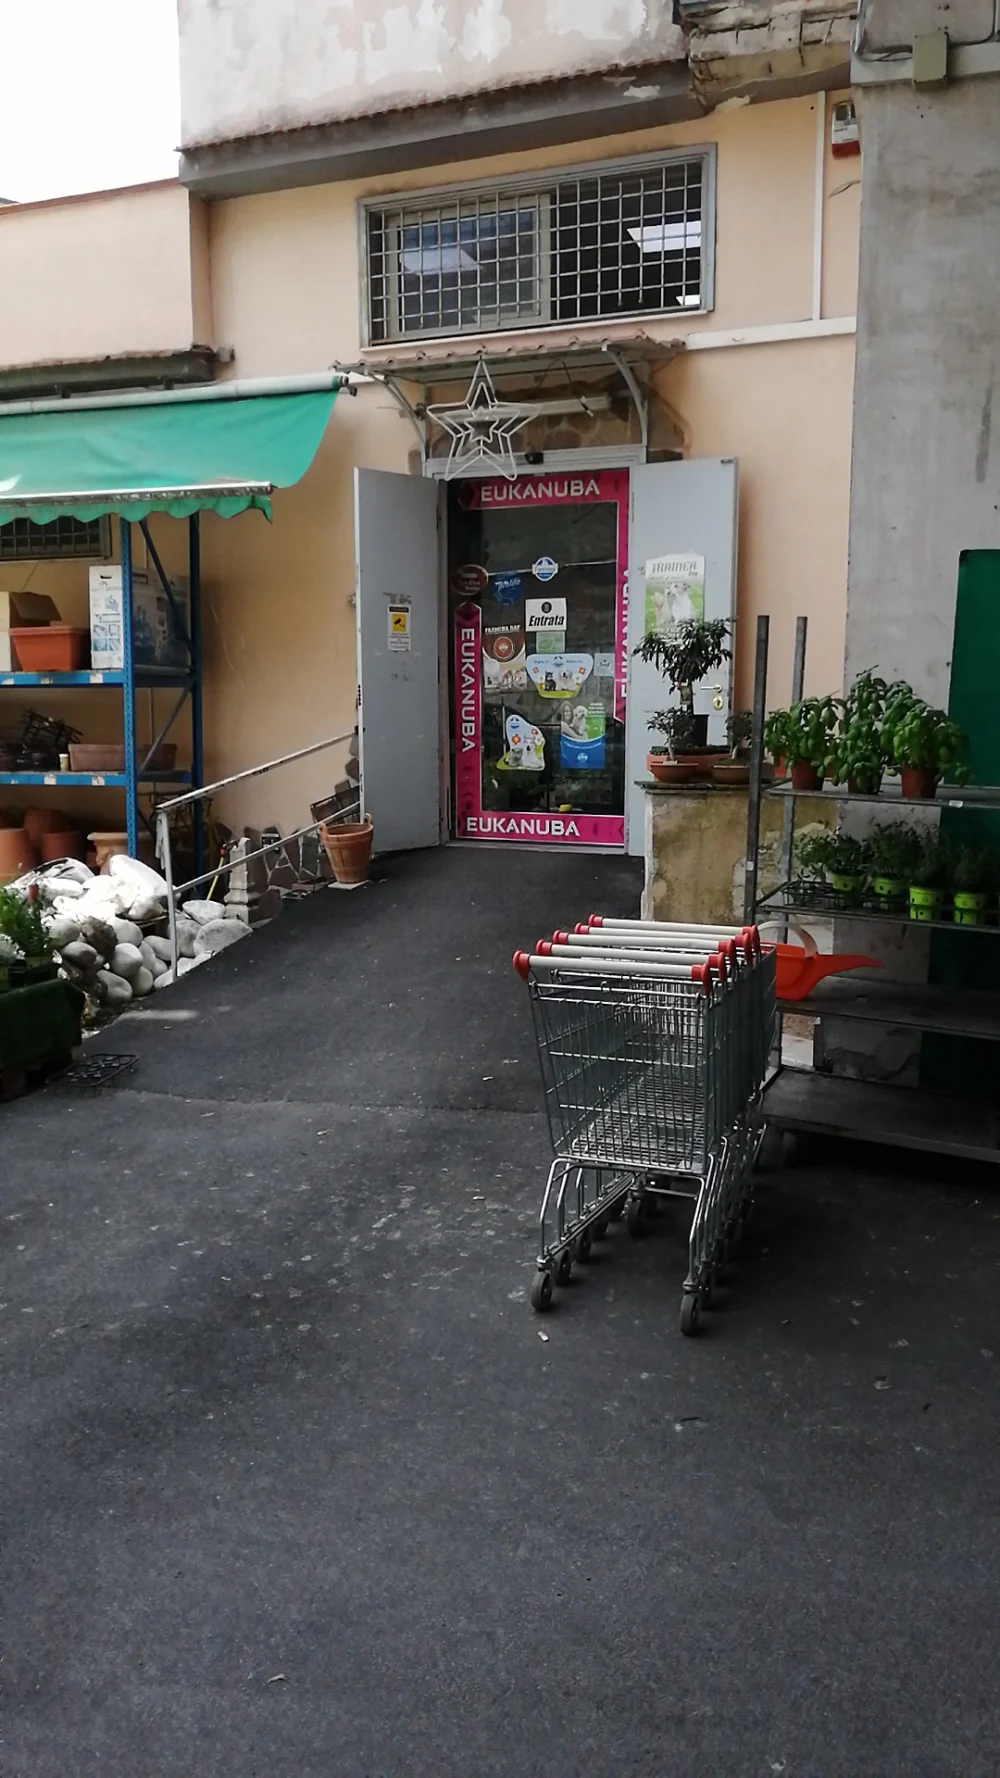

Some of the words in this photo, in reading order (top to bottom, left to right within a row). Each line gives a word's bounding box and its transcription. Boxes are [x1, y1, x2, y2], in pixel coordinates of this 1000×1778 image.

[481, 479, 600, 501] EUKANUBA
[652, 561, 697, 573] TRAINER
[529, 615, 565, 627] Entrata
[461, 628, 476, 753] EUKANUBA
[466, 817, 580, 837] EUKANUBA
